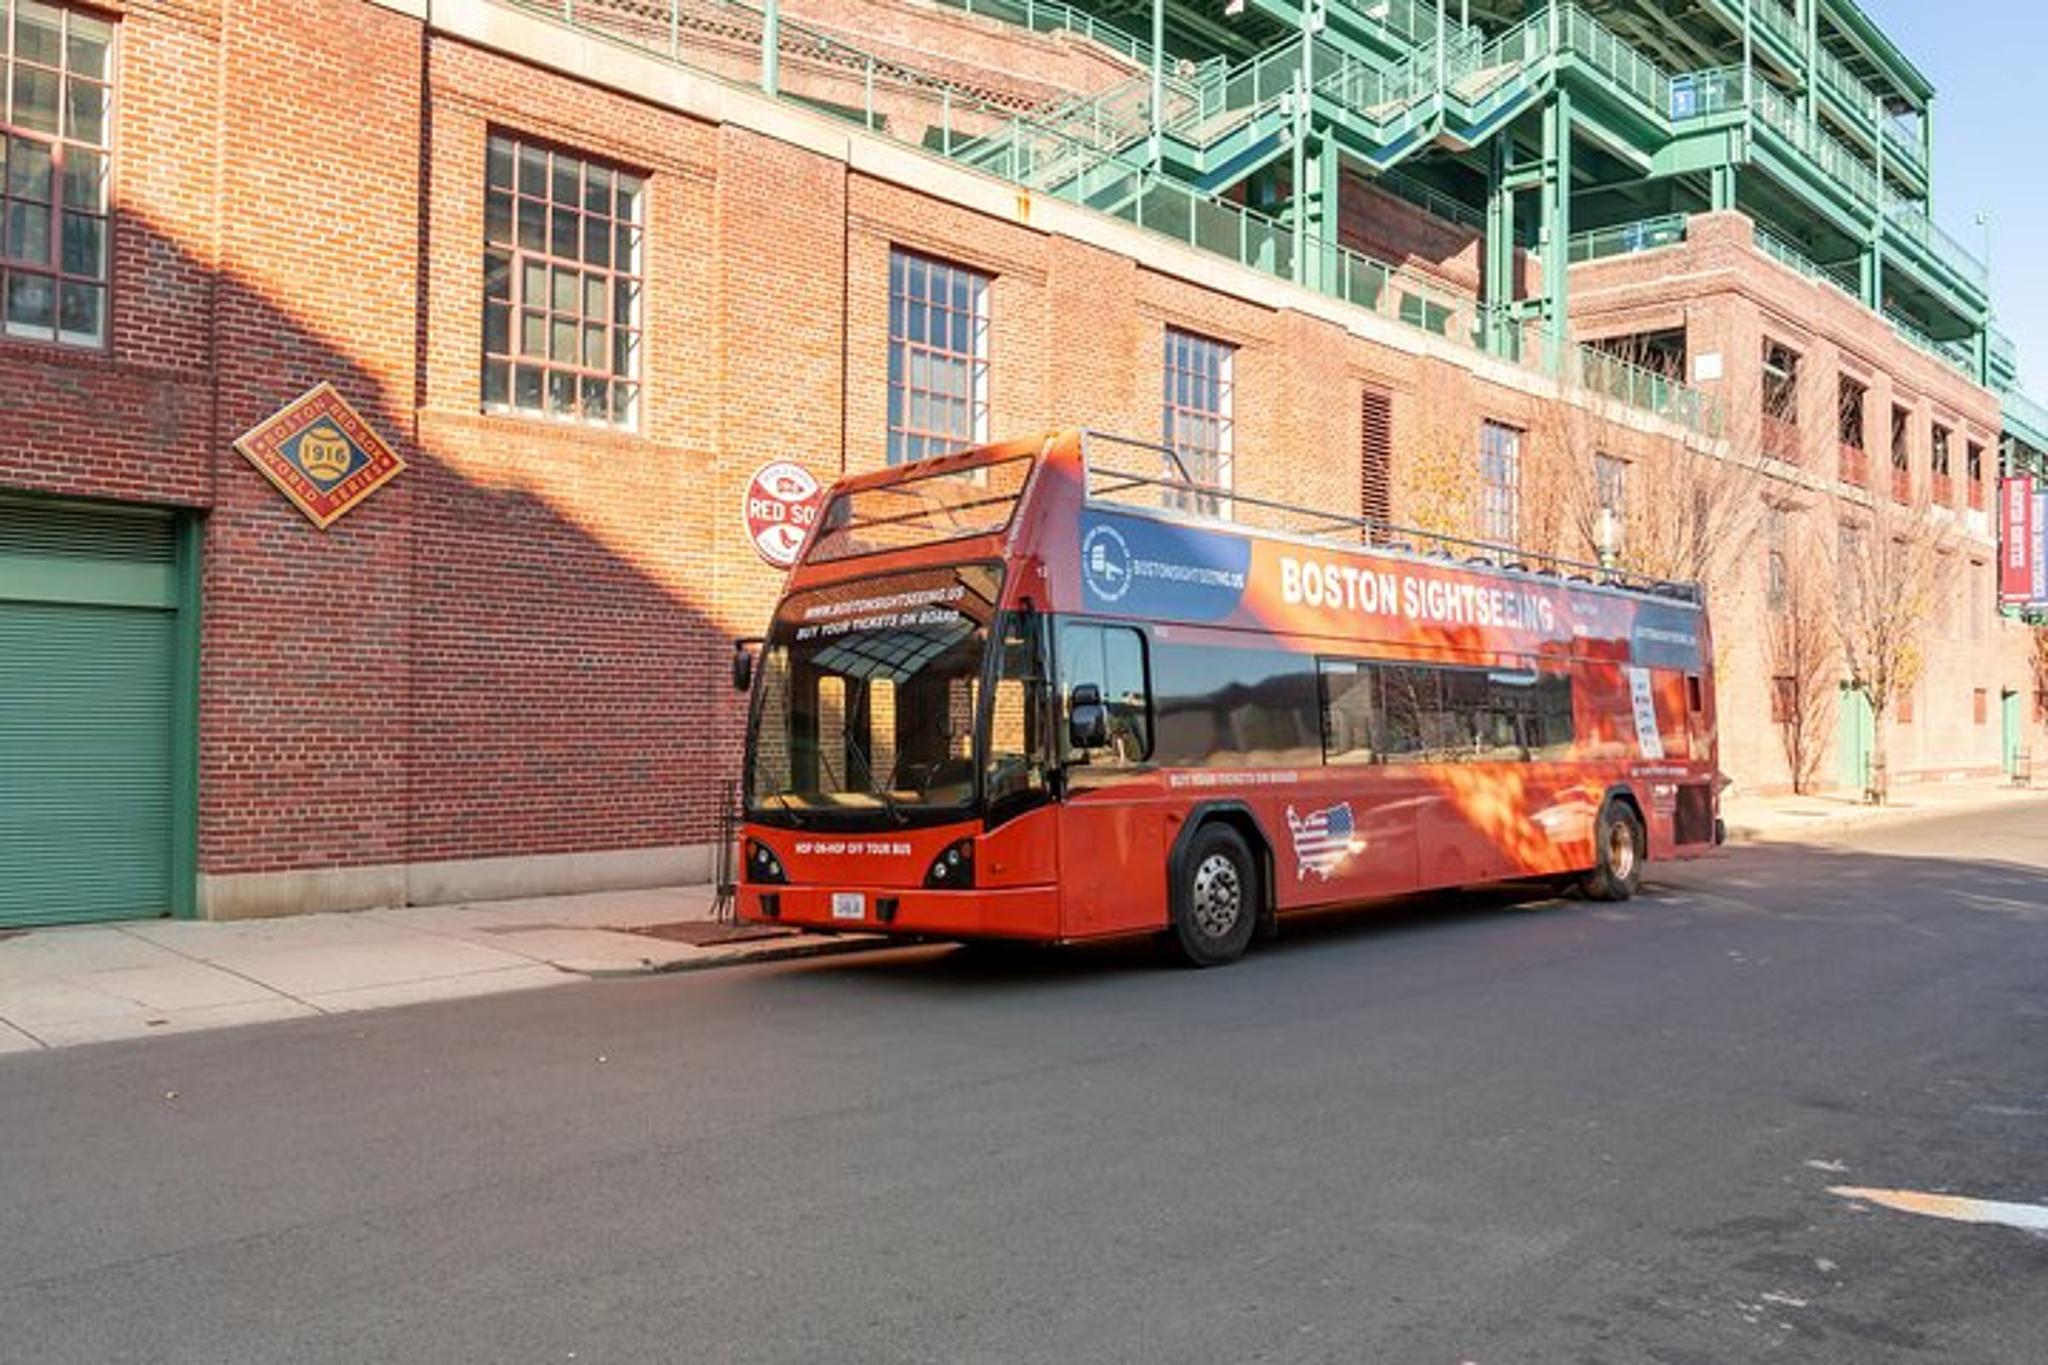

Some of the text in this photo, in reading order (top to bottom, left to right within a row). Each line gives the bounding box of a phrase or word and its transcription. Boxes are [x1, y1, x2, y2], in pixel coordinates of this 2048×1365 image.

[263, 398, 386, 459] BOSTON RED SOX
[303, 443, 346, 463] 1916
[263, 449, 384, 506] WORLD SERIES
[750, 499, 816, 525] RED SO
[1280, 557, 1554, 633] BOSTON SIGHTSEEING
[821, 621, 850, 636] YOUR
[852, 614, 897, 630] TICKETS
[901, 613, 917, 624] ON
[919, 611, 960, 624] BOARD
[795, 842, 812, 854] HOP
[866, 842, 890, 855] TOUR
[892, 843, 911, 856] BUS
